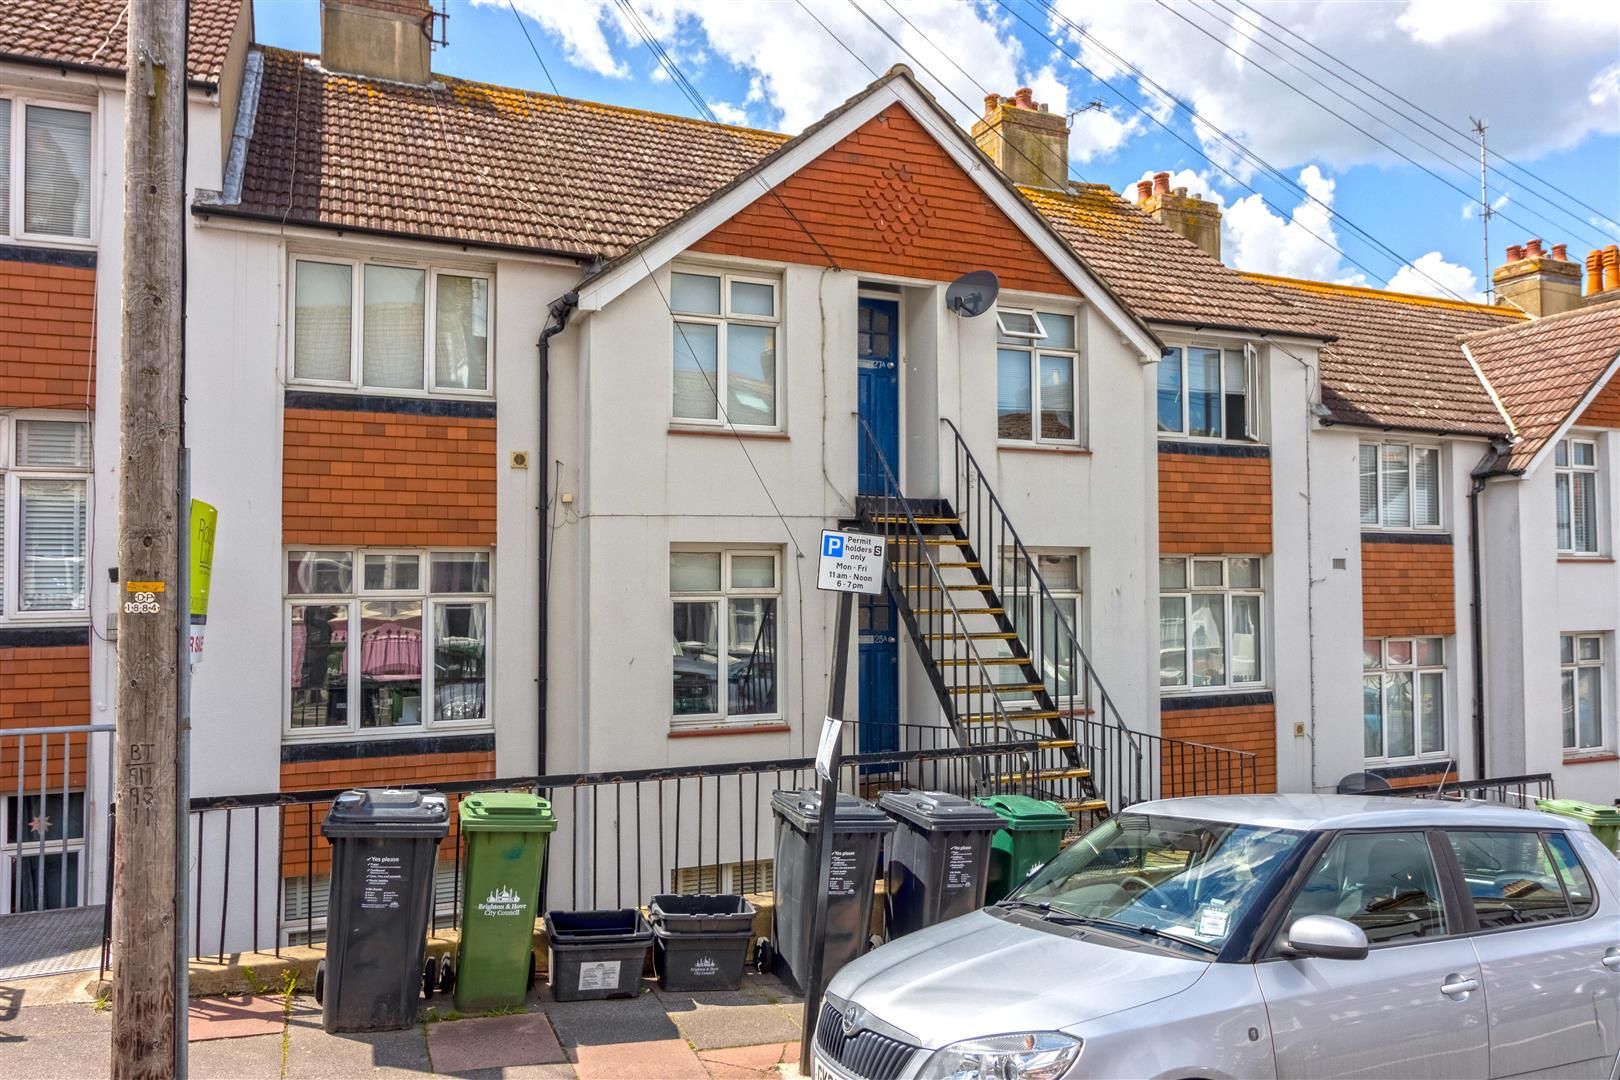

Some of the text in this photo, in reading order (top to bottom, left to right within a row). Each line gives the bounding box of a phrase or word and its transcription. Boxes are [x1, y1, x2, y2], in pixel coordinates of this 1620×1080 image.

[847, 536, 871, 545] Permit
[828, 537, 841, 555] P
[845, 545, 872, 554] holders
[850, 554, 866, 562] only
[836, 562, 852, 571] Mon
[858, 564, 868, 572] Fri
[853, 574, 872, 582] Noon
[836, 579, 842, 587] 6
[127, 604, 157, 612] 1884
[130, 743, 155, 761] BT
[478, 903, 505, 911] Brighton
[484, 909, 496, 917] City
